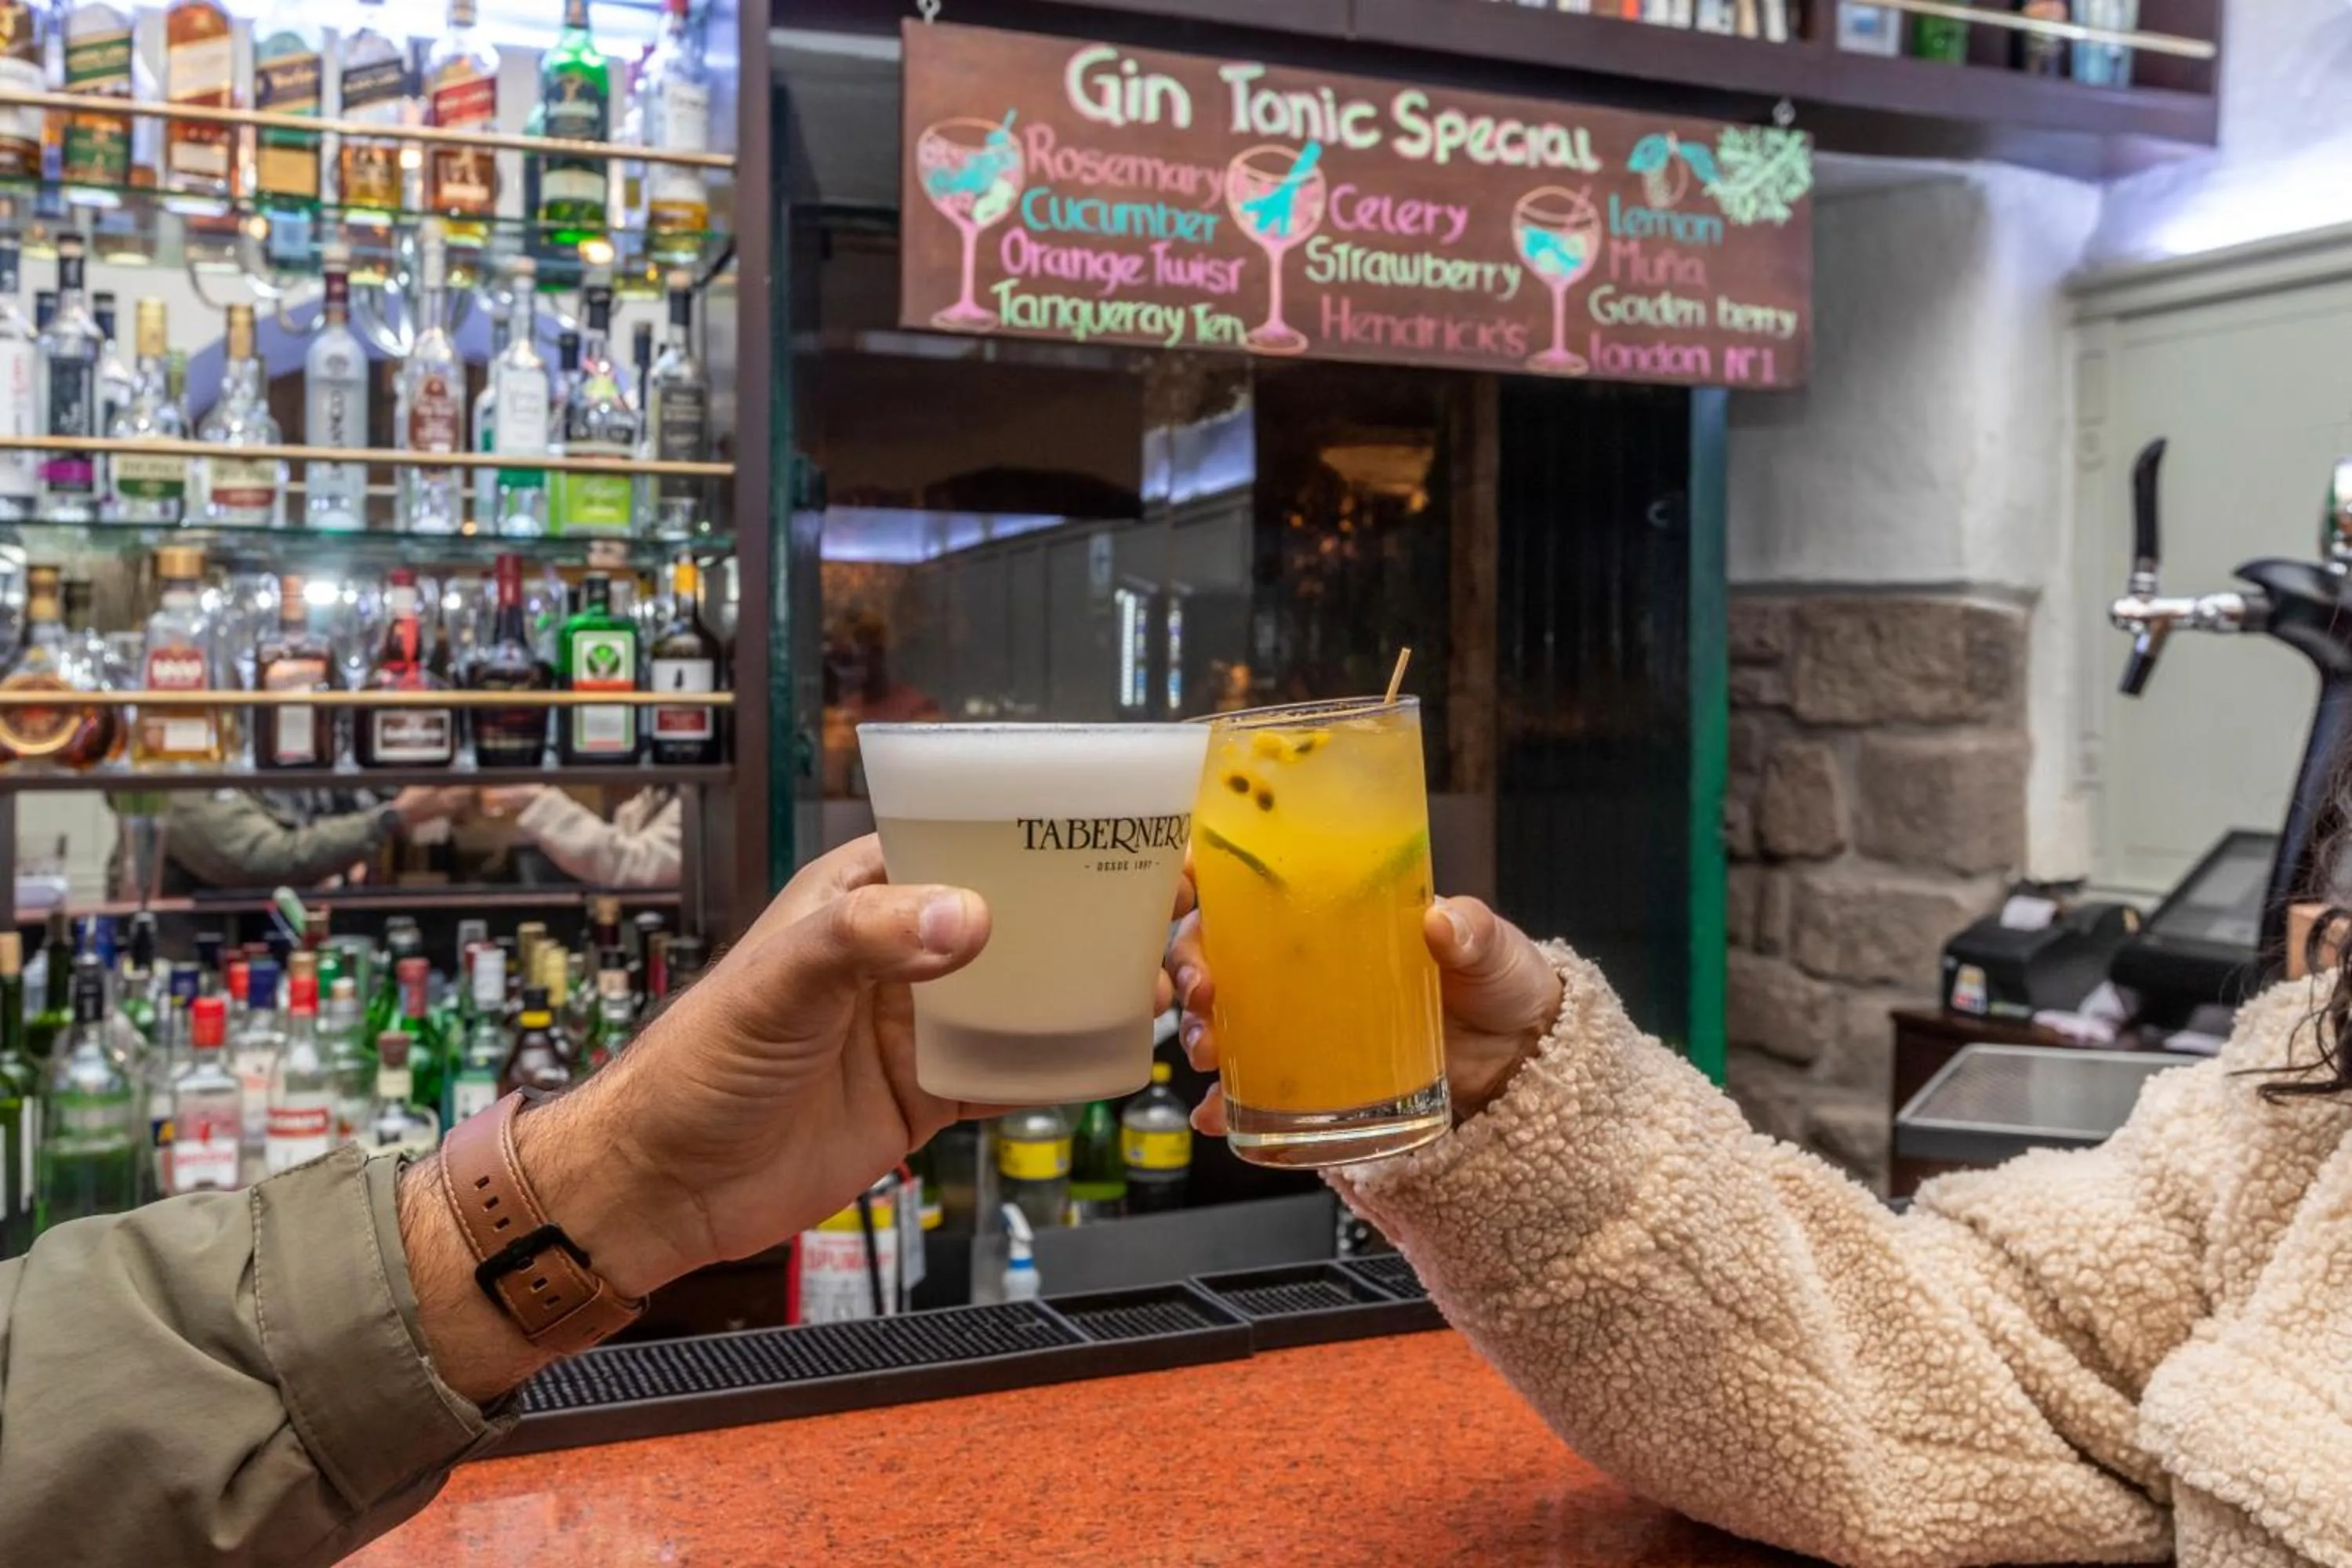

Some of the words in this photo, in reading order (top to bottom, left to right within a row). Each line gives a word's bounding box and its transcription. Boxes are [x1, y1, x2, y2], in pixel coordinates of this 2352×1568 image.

[1065, 43, 1192, 129] Gin
[1219, 61, 1381, 150] Tonic
[1391, 89, 1602, 173] Special
[1025, 123, 1225, 210] Rosemary
[1022, 187, 1222, 245] Cucumber
[1329, 183, 1468, 245] Celery
[1608, 192, 1723, 248] Lemon
[1000, 227, 1149, 296] Orange
[1149, 241, 1247, 293] Twist
[1305, 234, 1523, 303] Strawberry
[990, 278, 1185, 347] Tanqueray
[1192, 303, 1248, 345] Ten
